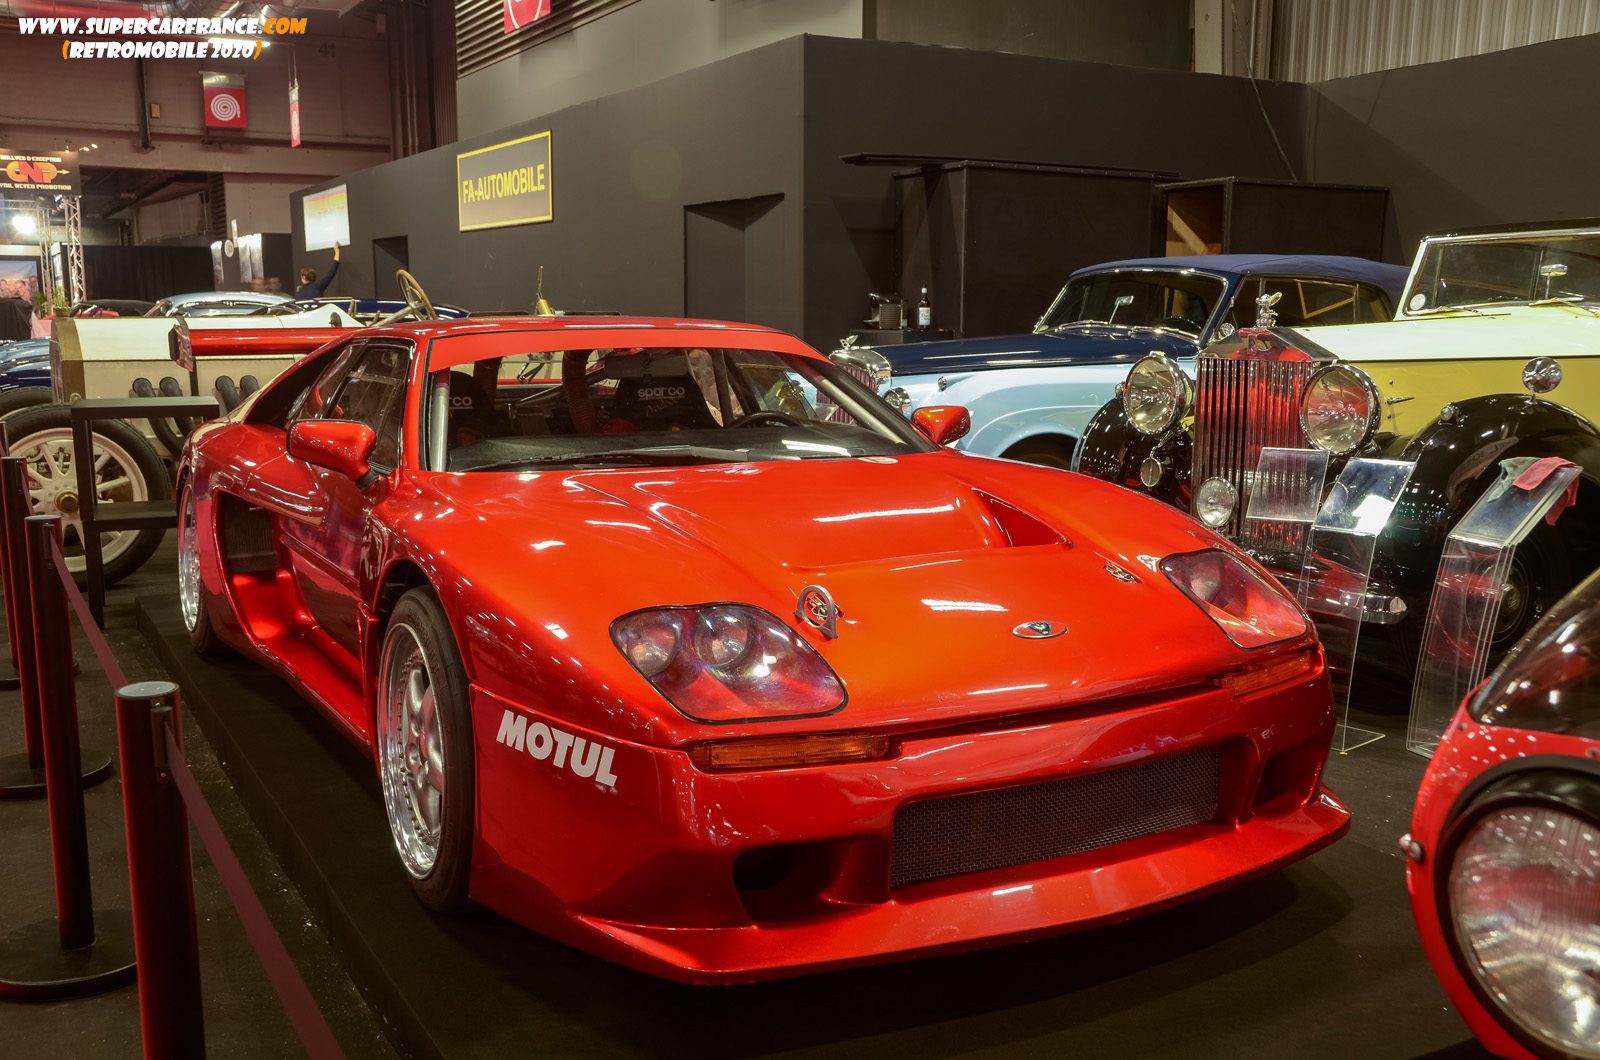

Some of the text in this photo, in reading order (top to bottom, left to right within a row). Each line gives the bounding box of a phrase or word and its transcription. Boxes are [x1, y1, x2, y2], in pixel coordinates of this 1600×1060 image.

[318, 42, 336, 58] 41
[463, 164, 546, 204] FA-AUTOMOBILE
[637, 386, 686, 400] sparco
[496, 709, 618, 787] MOTUL
